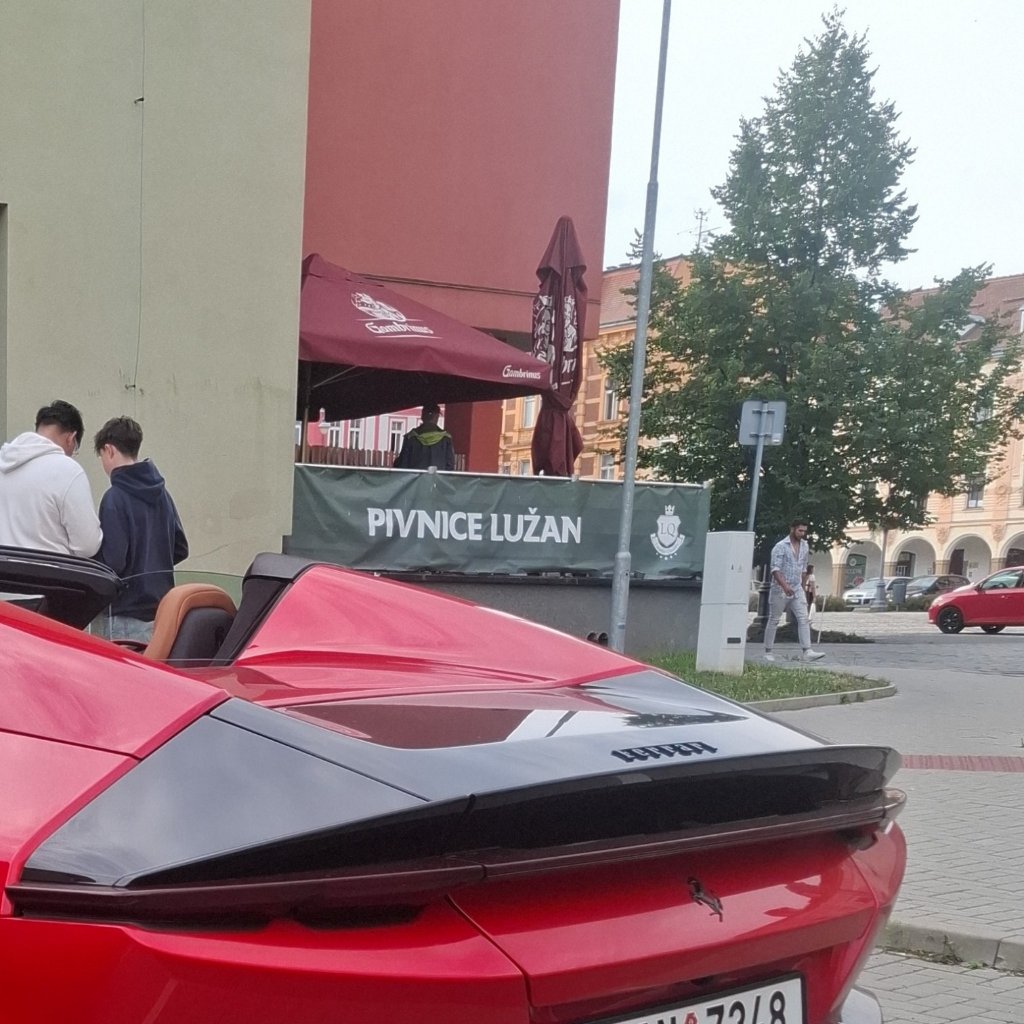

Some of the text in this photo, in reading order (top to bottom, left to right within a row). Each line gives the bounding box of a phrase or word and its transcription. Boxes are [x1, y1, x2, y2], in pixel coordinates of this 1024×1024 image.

[502, 364, 541, 379] Gambrinus
[367, 507, 582, 544] PIVNICE LUŽAN
